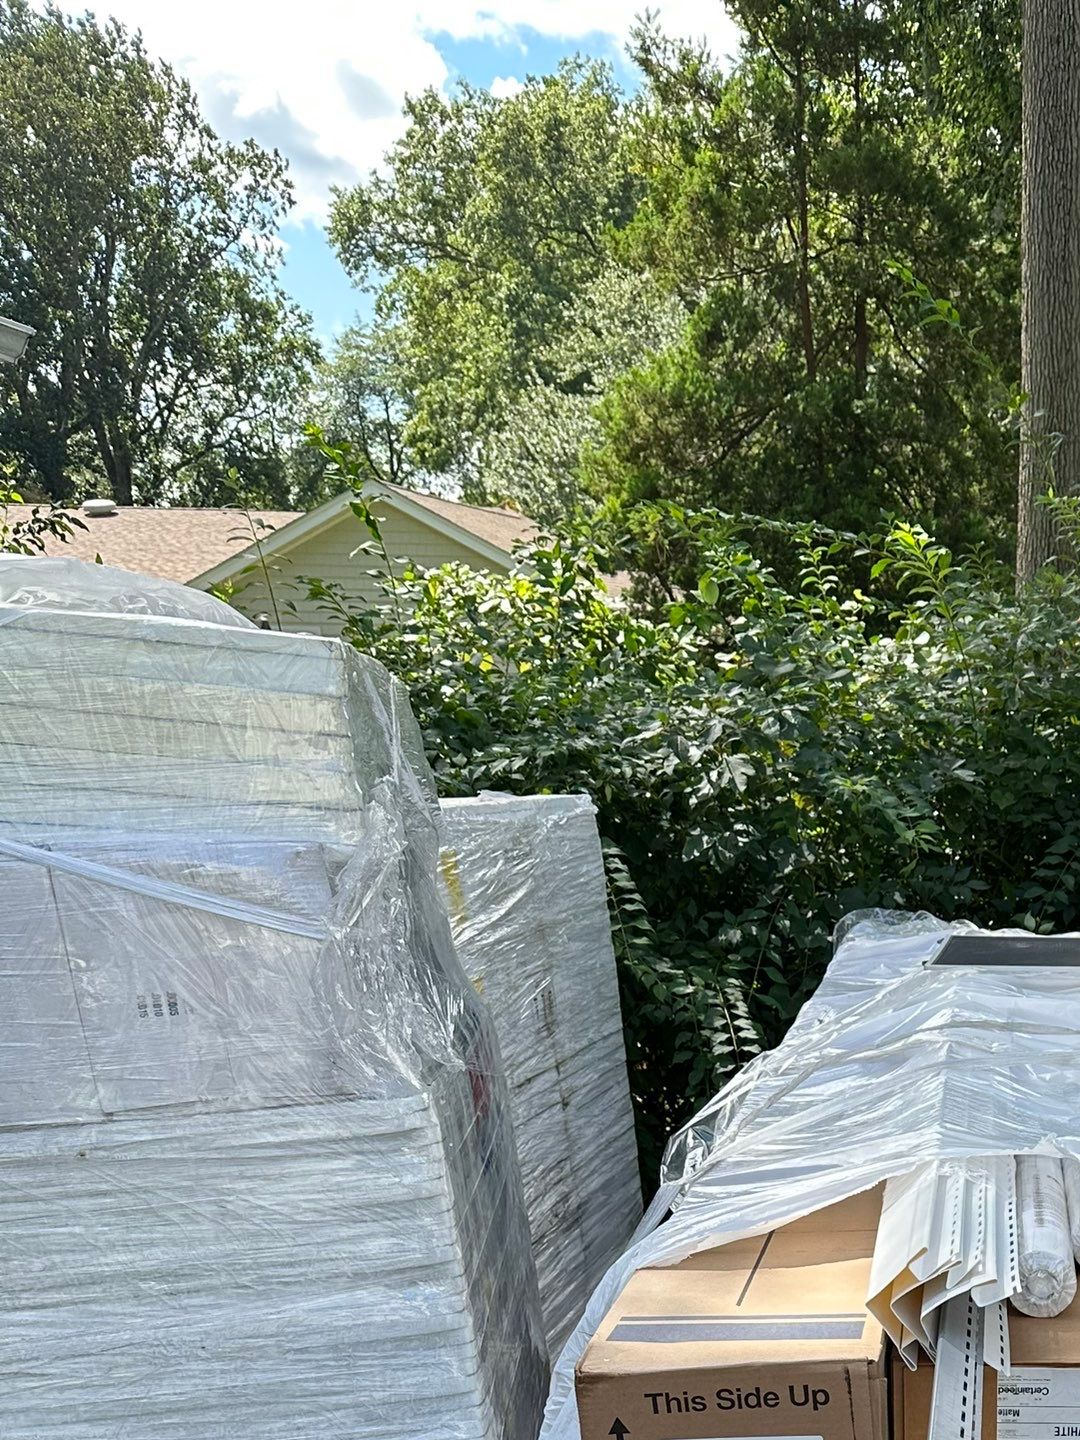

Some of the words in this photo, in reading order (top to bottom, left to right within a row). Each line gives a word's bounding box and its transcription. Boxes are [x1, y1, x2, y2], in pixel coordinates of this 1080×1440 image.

[998, 1386, 1049, 1395] CertainTeed
[644, 1391, 707, 1414] This
[716, 1387, 780, 1410] Side
[789, 1385, 830, 1410] Up
[998, 1409, 1020, 1417] Matte
